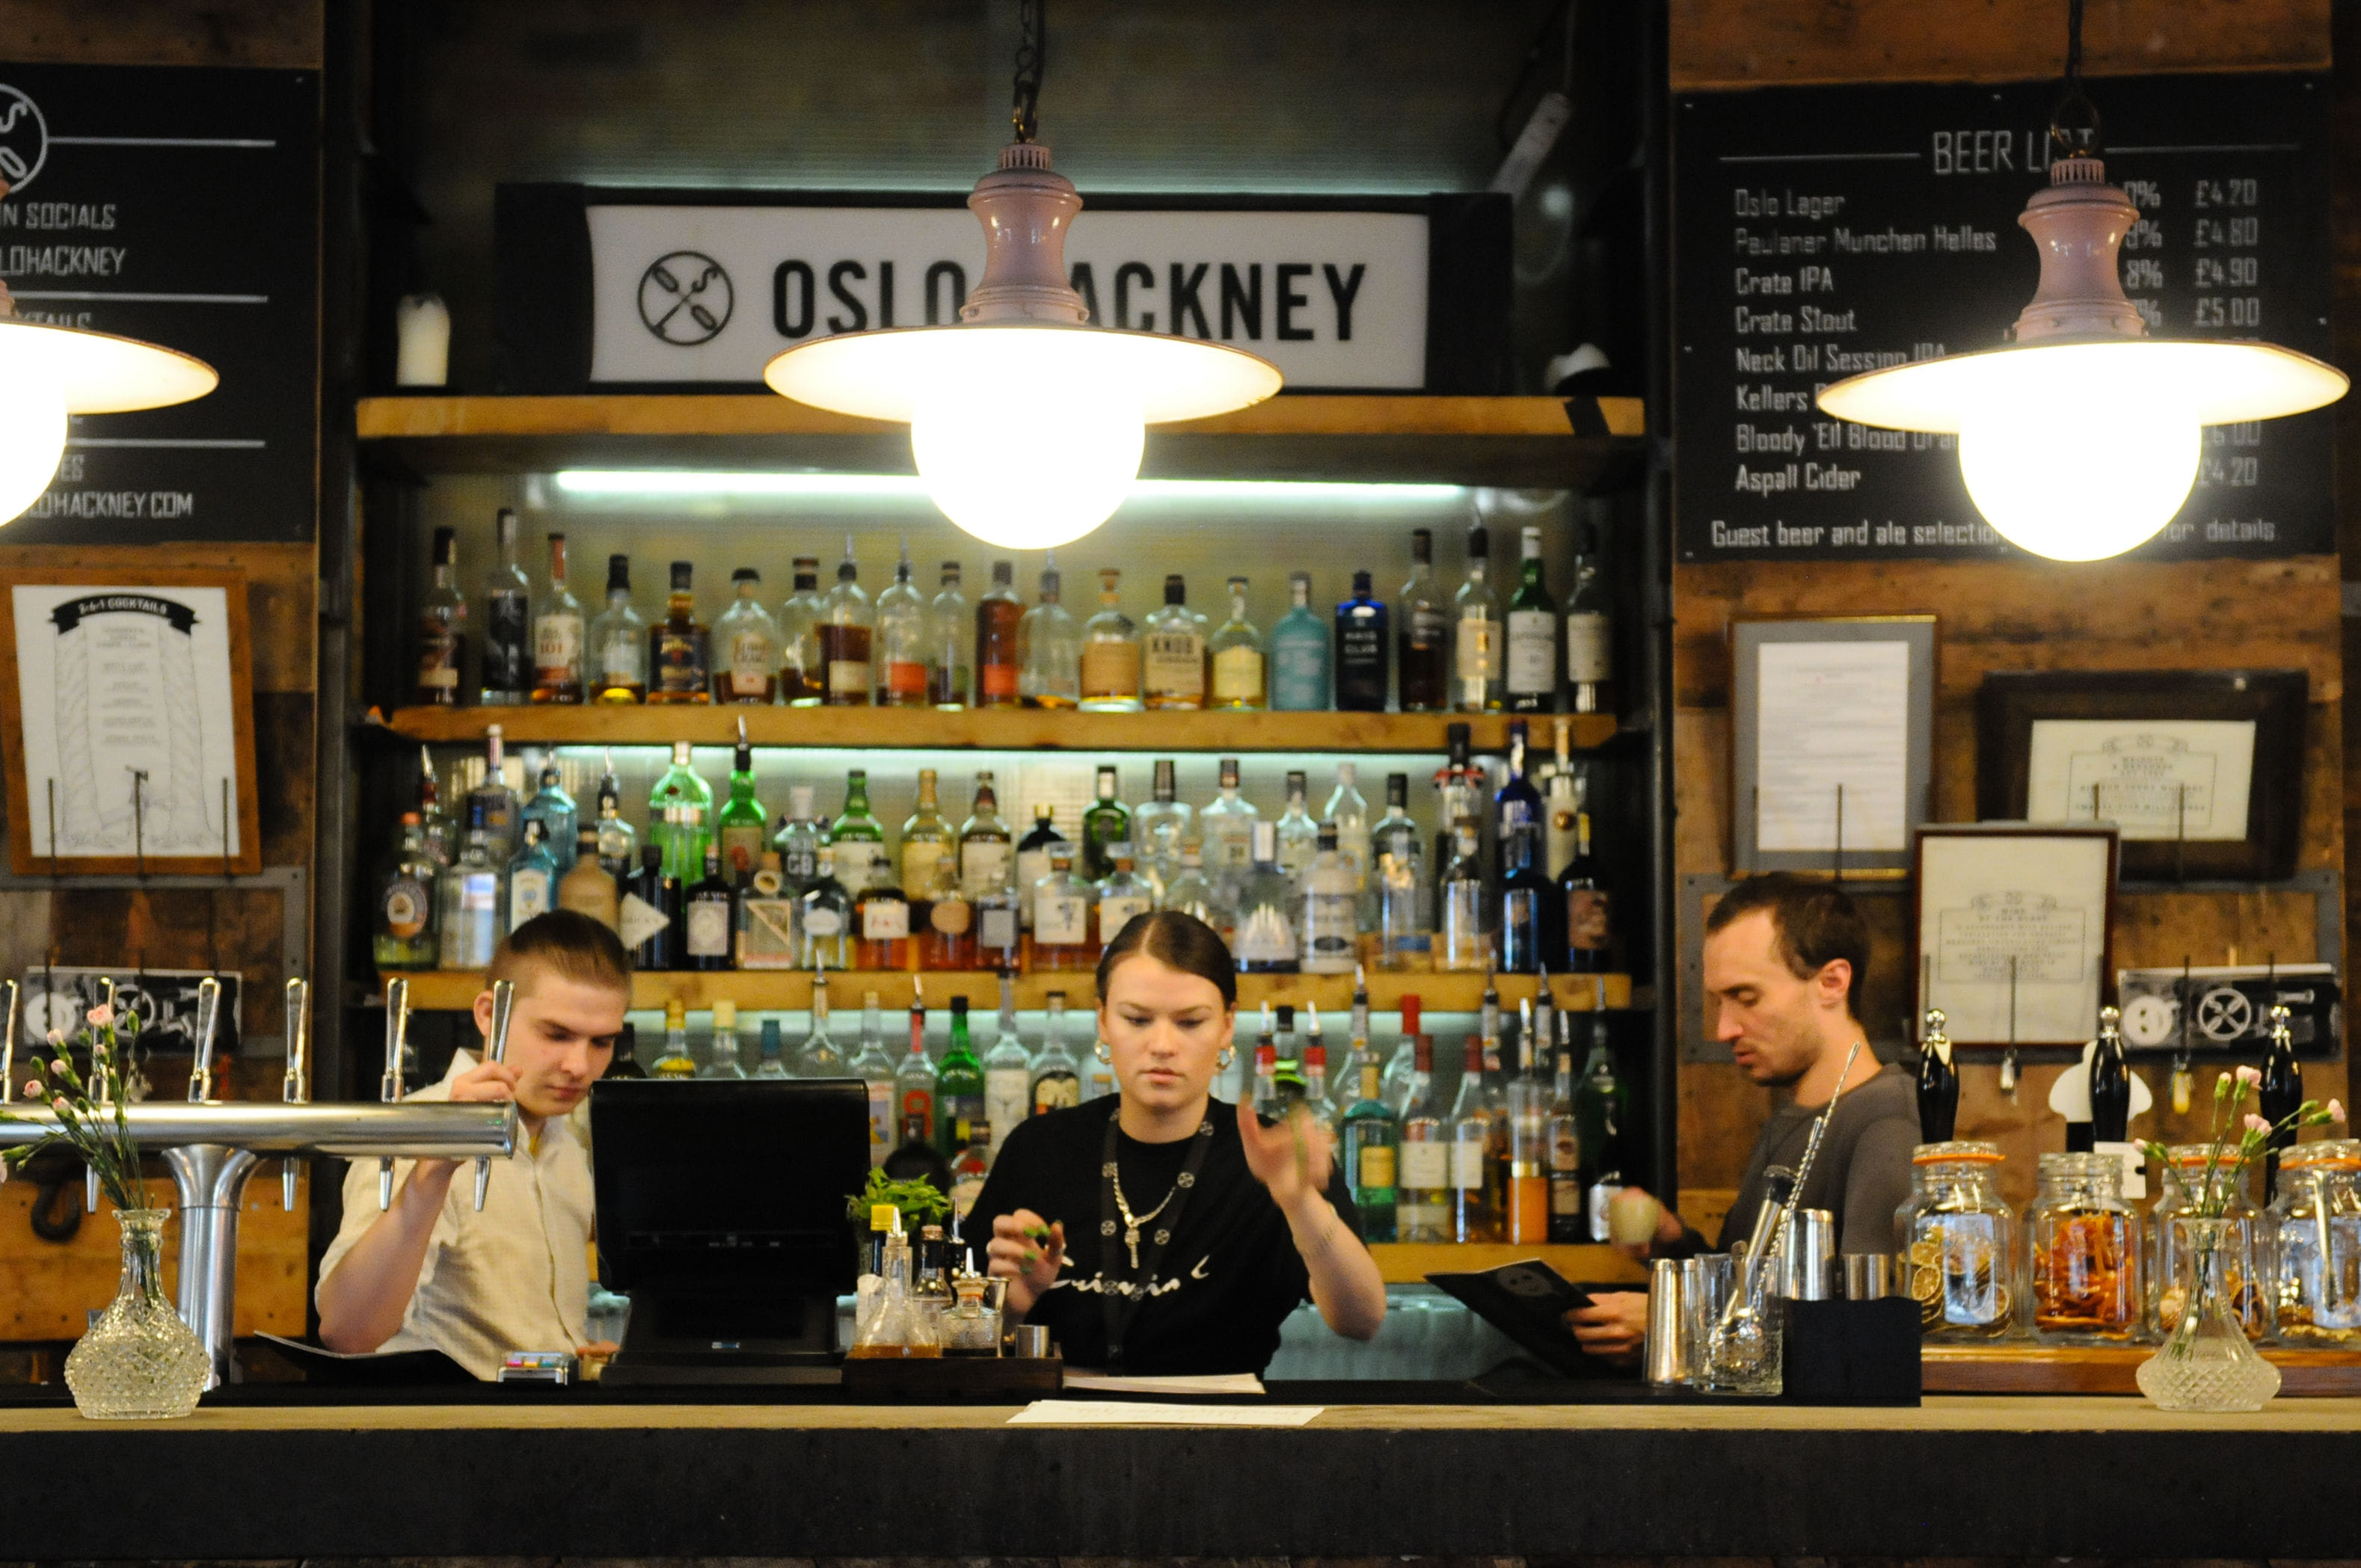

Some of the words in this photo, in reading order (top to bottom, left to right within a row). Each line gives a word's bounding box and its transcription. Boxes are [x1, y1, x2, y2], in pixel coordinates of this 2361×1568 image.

[1933, 130, 2014, 175] BEER
[25, 202, 117, 230] SOCIALS
[1734, 188, 1779, 217] Oslo
[1787, 188, 1846, 220] Lager
[1934, 224, 1997, 253] Helles
[0, 245, 126, 277] LOHACKNEY
[1735, 267, 1793, 295] Crate
[1799, 265, 1835, 292] IPA
[773, 259, 966, 339] OSLO
[1069, 262, 1366, 341] ACKNEY
[1735, 305, 1793, 333] Crate
[1800, 305, 1858, 333] Stout
[1736, 346, 1786, 372] Neck
[1795, 344, 1819, 372] Oil
[1826, 343, 1907, 372] Session
[1736, 384, 1808, 412] Kellers
[1736, 422, 1805, 457] Bloody
[1848, 422, 1906, 450] Blood
[1735, 462, 1798, 499] Aspall
[1805, 461, 1862, 491] Cider
[1711, 520, 1770, 548] Guest
[1778, 520, 1825, 547] beer
[1832, 519, 1869, 547] and
[1876, 520, 1907, 547] ale
[107, 597, 168, 615] COCKTAILS
